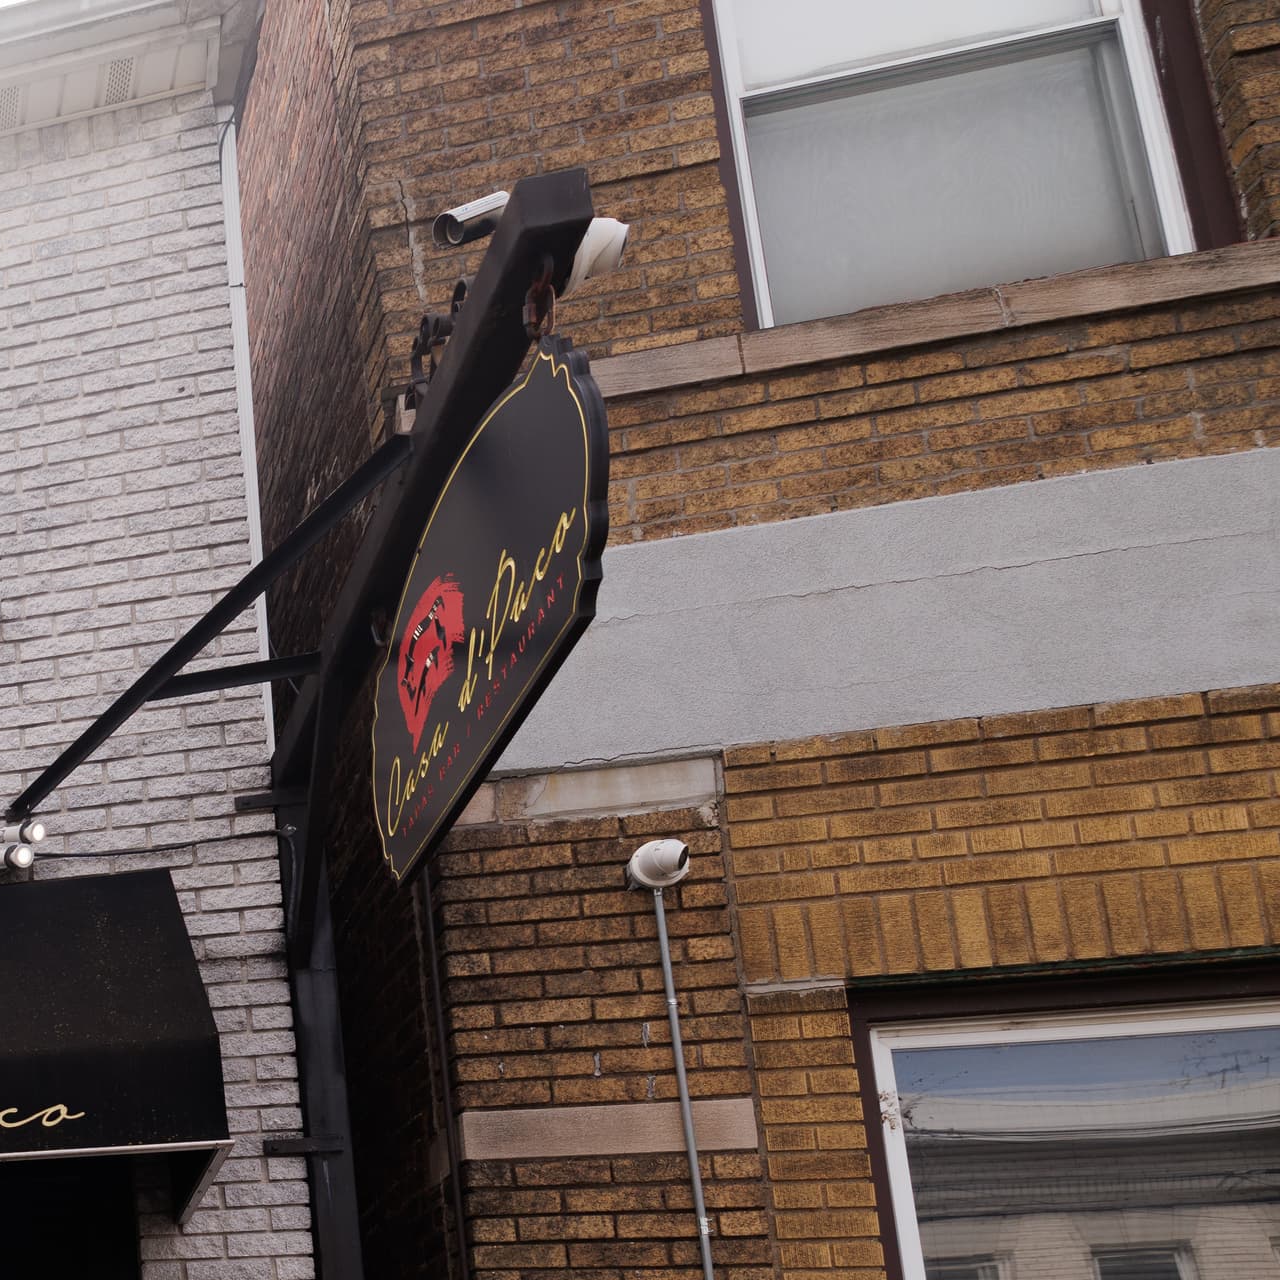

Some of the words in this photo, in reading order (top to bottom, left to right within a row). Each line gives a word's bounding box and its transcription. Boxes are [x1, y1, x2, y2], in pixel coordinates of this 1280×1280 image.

[387, 721, 449, 837] Casa
[458, 507, 577, 713] d'Paco
[476, 571, 565, 721] RESTAURANT
